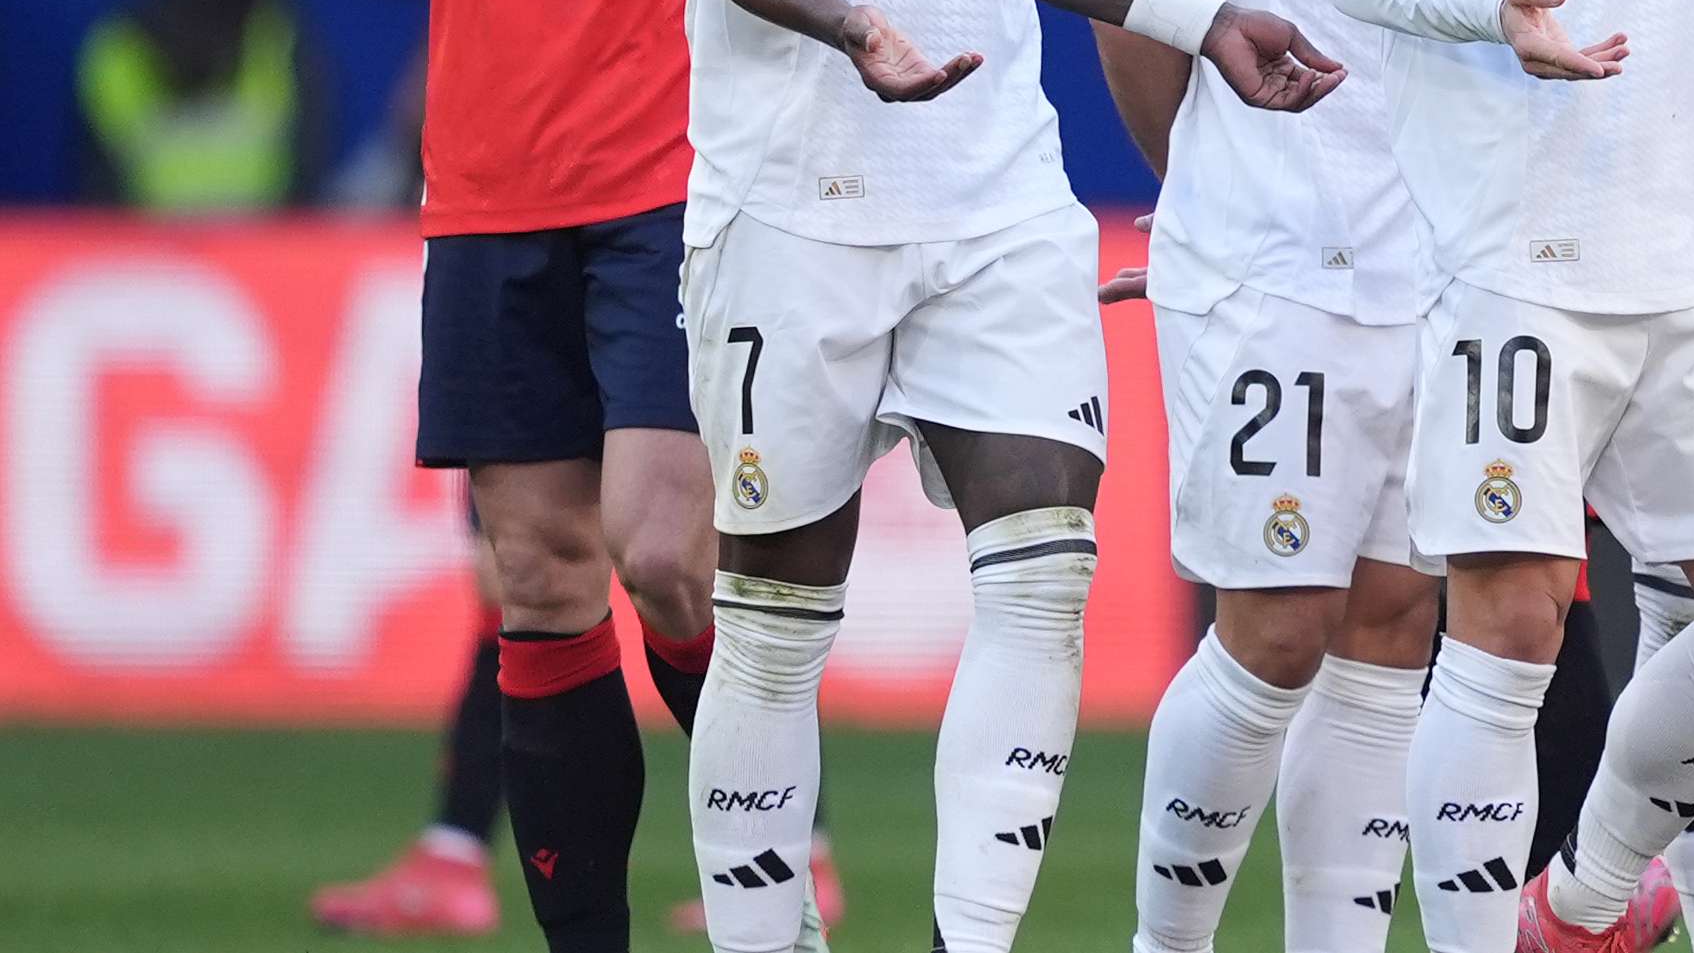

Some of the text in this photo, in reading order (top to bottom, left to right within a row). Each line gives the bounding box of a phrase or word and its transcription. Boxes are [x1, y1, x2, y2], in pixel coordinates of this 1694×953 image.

[727, 326, 764, 435] 7
[1452, 335, 1552, 445] 10
[1230, 369, 1325, 477] 21
[1005, 747, 1068, 775] RMC
[707, 786, 797, 811] RMCF
[1166, 798, 1252, 828] RMCF
[1436, 802, 1524, 822] RMCF
[1362, 818, 1410, 843] RM
